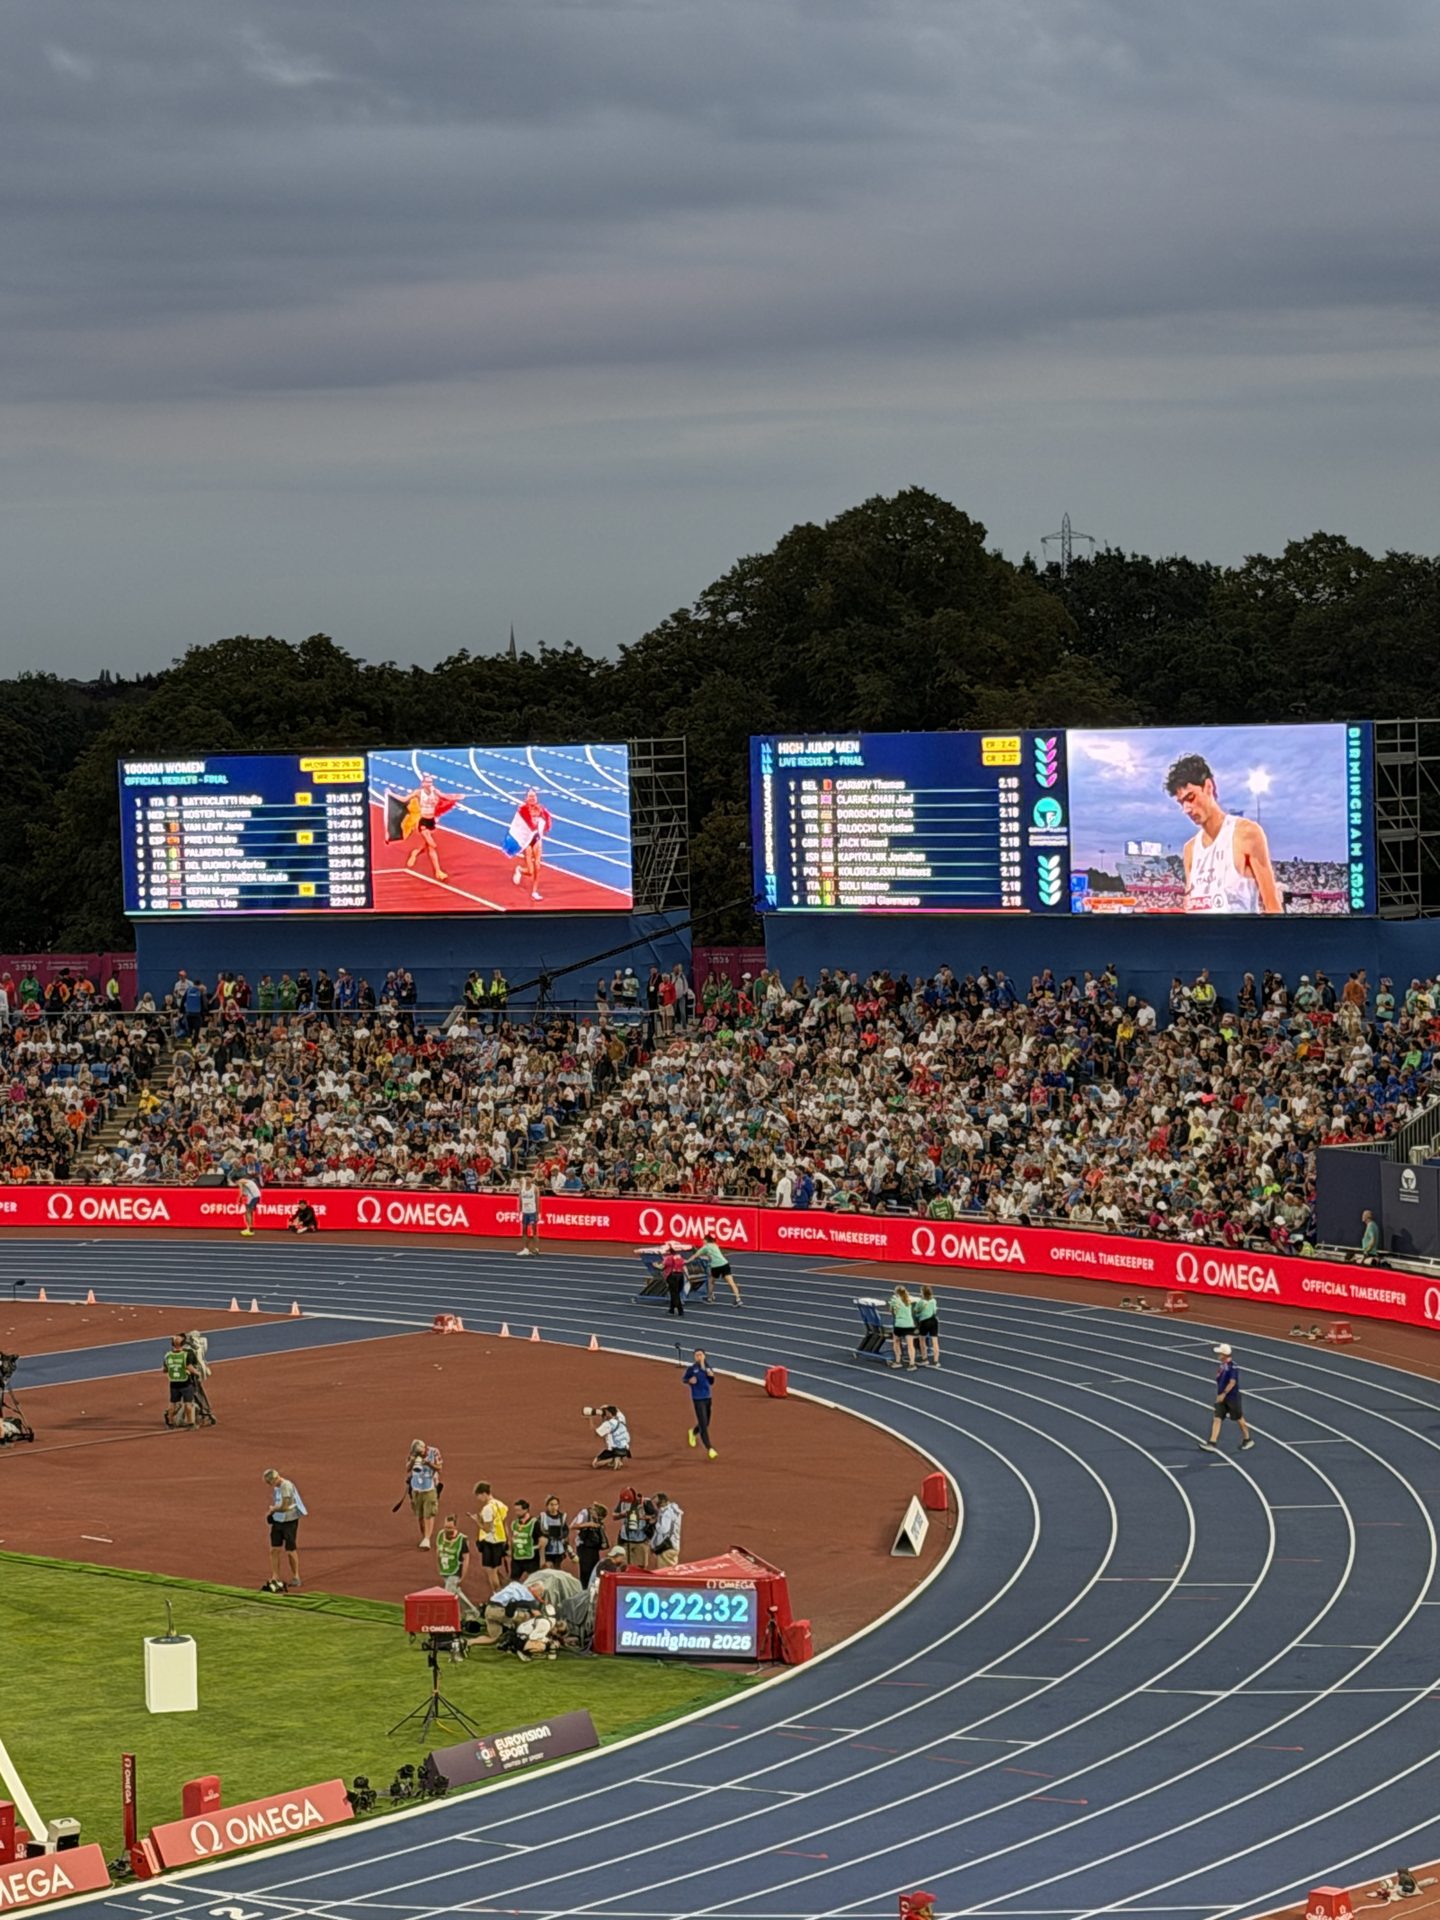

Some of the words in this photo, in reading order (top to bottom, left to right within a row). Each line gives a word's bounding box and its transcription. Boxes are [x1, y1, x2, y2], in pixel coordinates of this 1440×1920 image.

[778, 742, 803, 754] HIGH
[805, 741, 835, 754] JUMP
[836, 741, 860, 753] MEN
[124, 762, 163, 774] 10000M
[165, 761, 205, 773] WOMEN
[779, 757, 796, 767] LIVE
[798, 756, 833, 767] RESULTS
[839, 756, 864, 766] FINAL
[124, 776, 161, 786] OFFICIAL
[162, 775, 197, 785] RESULTS
[1348, 727, 1362, 856] BIRMINGHAM
[149, 797, 165, 807] ITA
[805, 824, 819, 833] ITA
[152, 849, 166, 858] ITA
[152, 861, 167, 871] ITA
[803, 866, 819, 876] POL
[150, 874, 167, 883] SLO
[806, 881, 820, 890] ITA
[1350, 862, 1365, 909] 2026
[807, 895, 821, 905] ITA
[79, 1198, 170, 1221] OMEGA
[200, 1203, 248, 1215] OFFICIA
[386, 1202, 469, 1227] OMEGA
[546, 1213, 610, 1227] TIMEKEEPER
[669, 1213, 748, 1243] OMEGA
[829, 1229, 888, 1246] TIMEKEEPER
[941, 1233, 1026, 1264] OMEGA
[1050, 1247, 1097, 1264] OFFICIAL
[1098, 1252, 1155, 1272] TIMEKEEPER
[1203, 1260, 1280, 1295] OMEGA
[1302, 1278, 1348, 1297] OFFICIAL
[1350, 1285, 1407, 1307] TIMEKEEPER
[718, 1580, 757, 1590] OMEGA
[625, 1591, 749, 1622] 20:22:32
[621, 1629, 710, 1651] Birmingham
[712, 1634, 752, 1650] 2026
[494, 1725, 552, 1750] EUROVISION
[499, 1743, 529, 1761] SPORT
[226, 1798, 324, 1845] OMEGA
[138, 1893, 184, 1904] 1
[209, 1906, 264, 1920] 2
